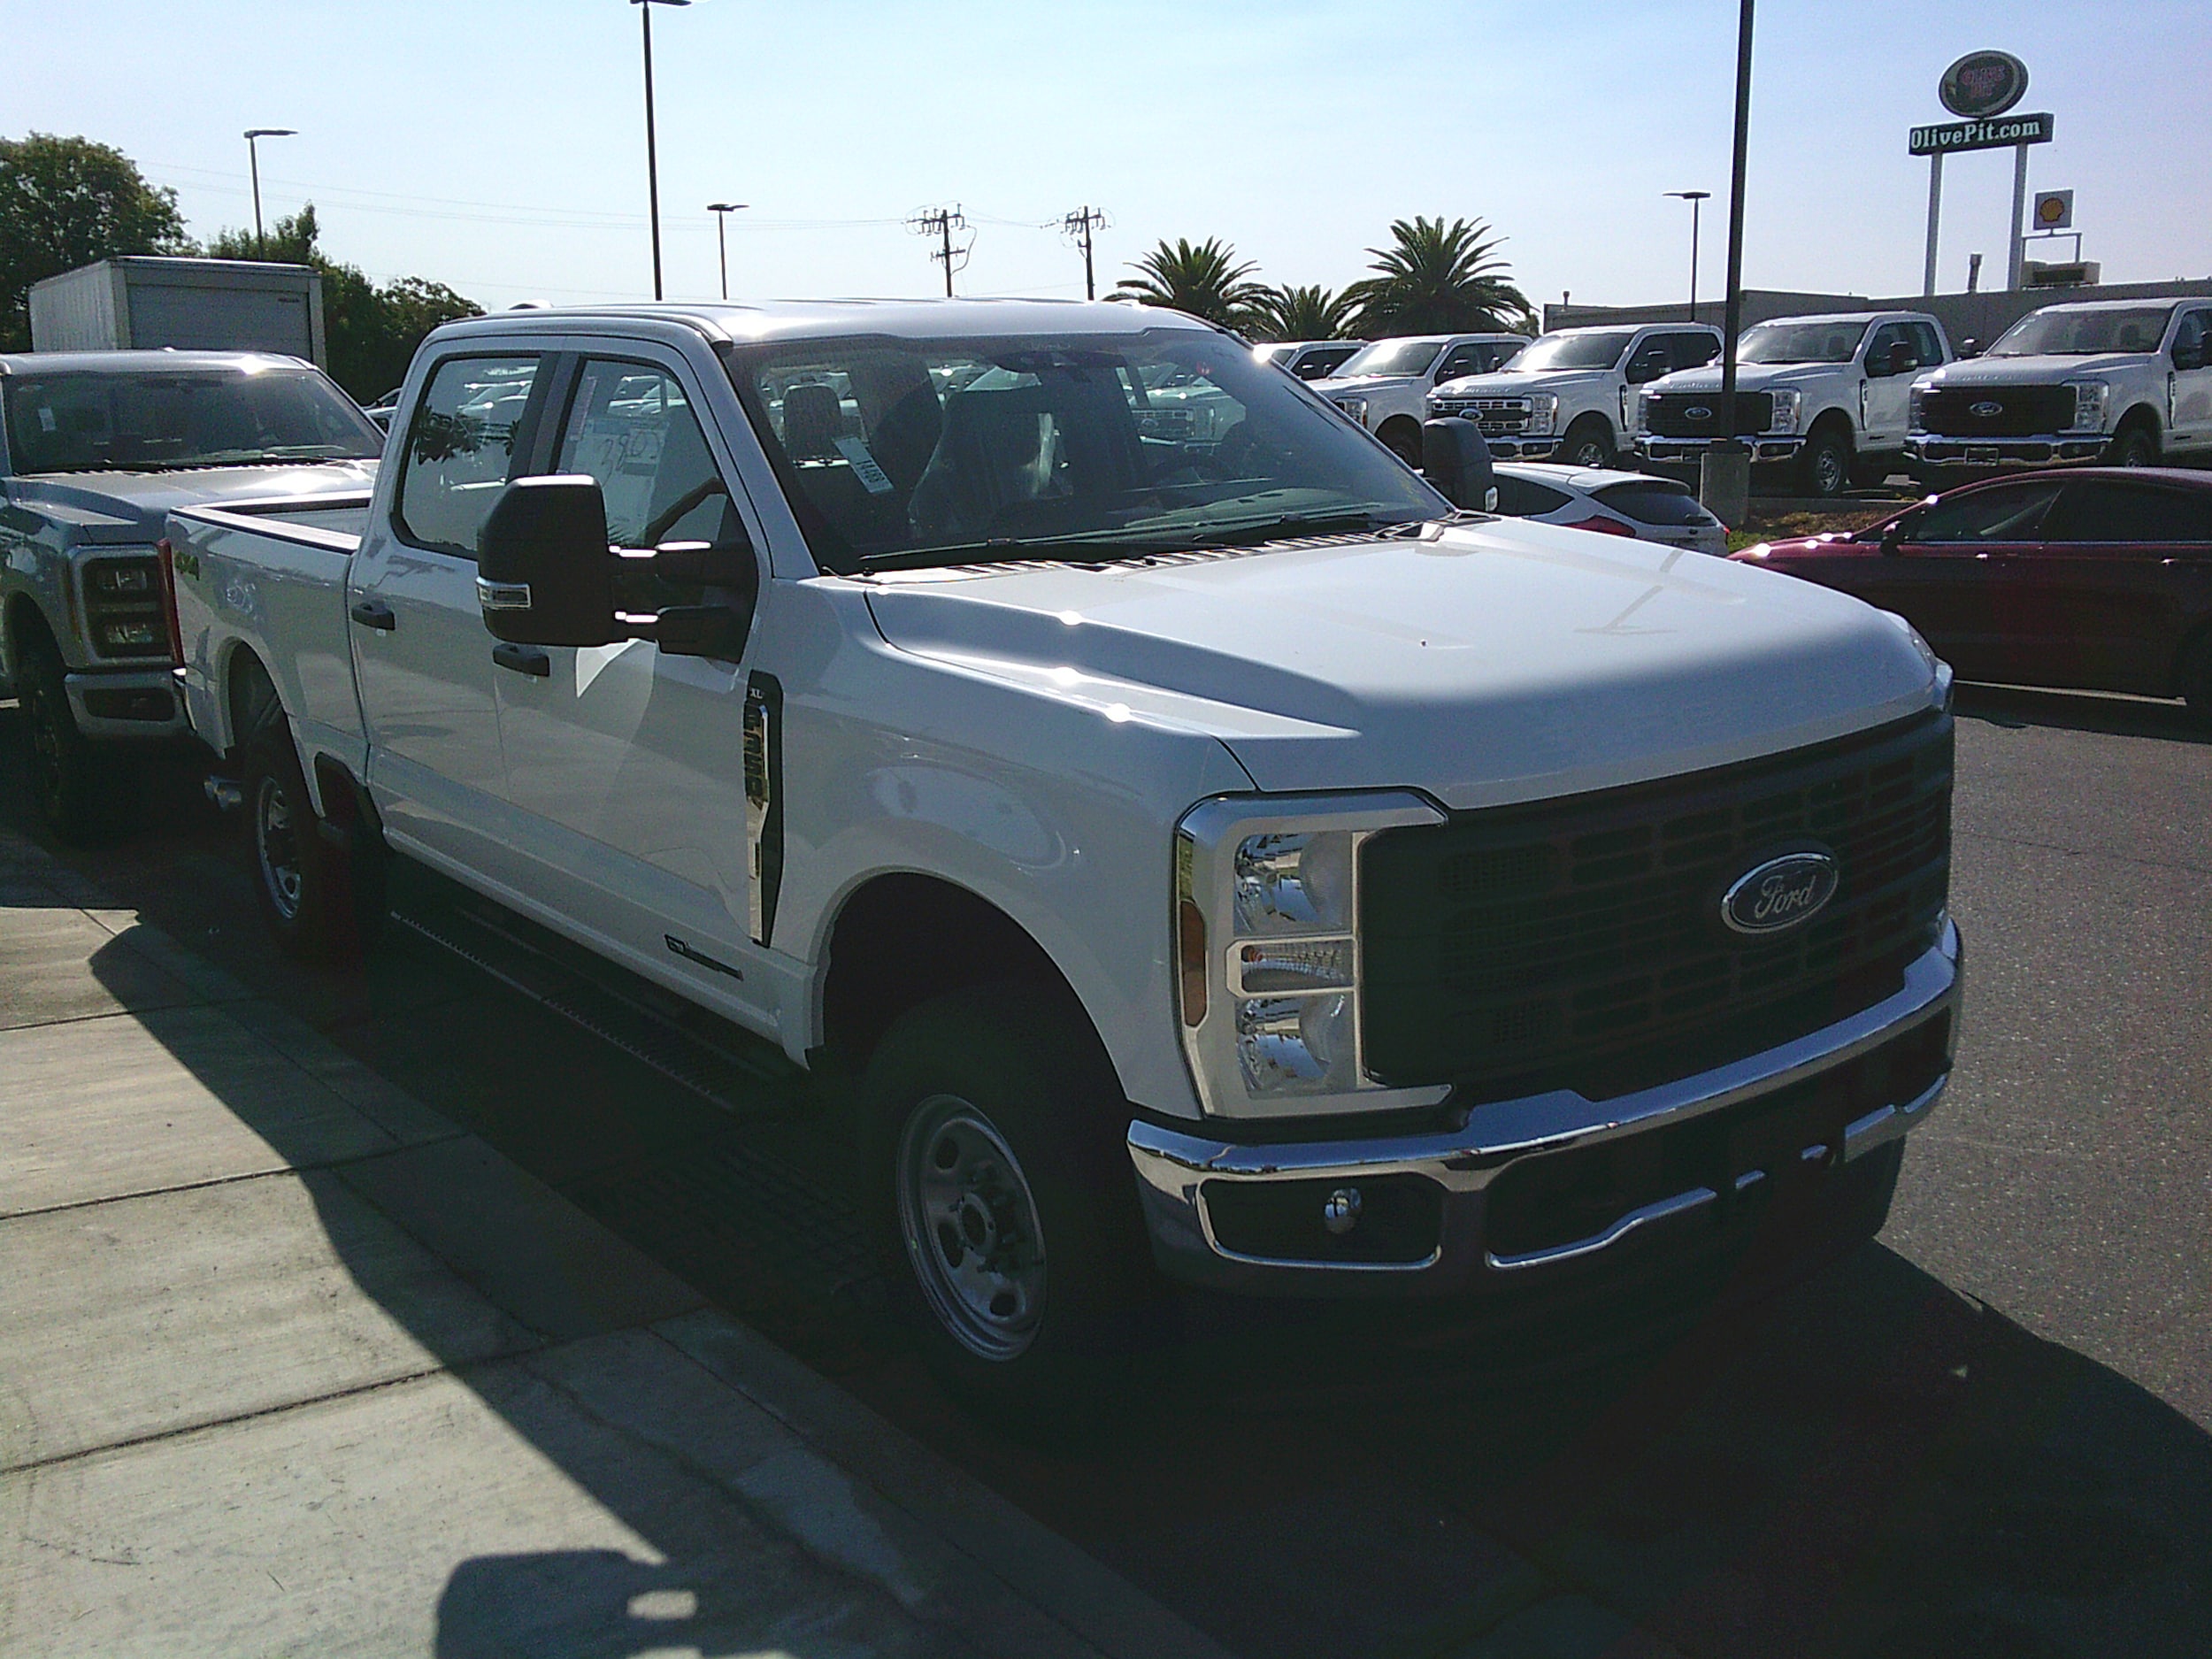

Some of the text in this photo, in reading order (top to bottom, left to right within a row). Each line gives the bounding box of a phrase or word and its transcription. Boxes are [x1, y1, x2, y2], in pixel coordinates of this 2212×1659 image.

[1911, 120, 2040, 149] OlivePit.com
[749, 687, 764, 700] XL
[1754, 874, 1816, 919] Ford
